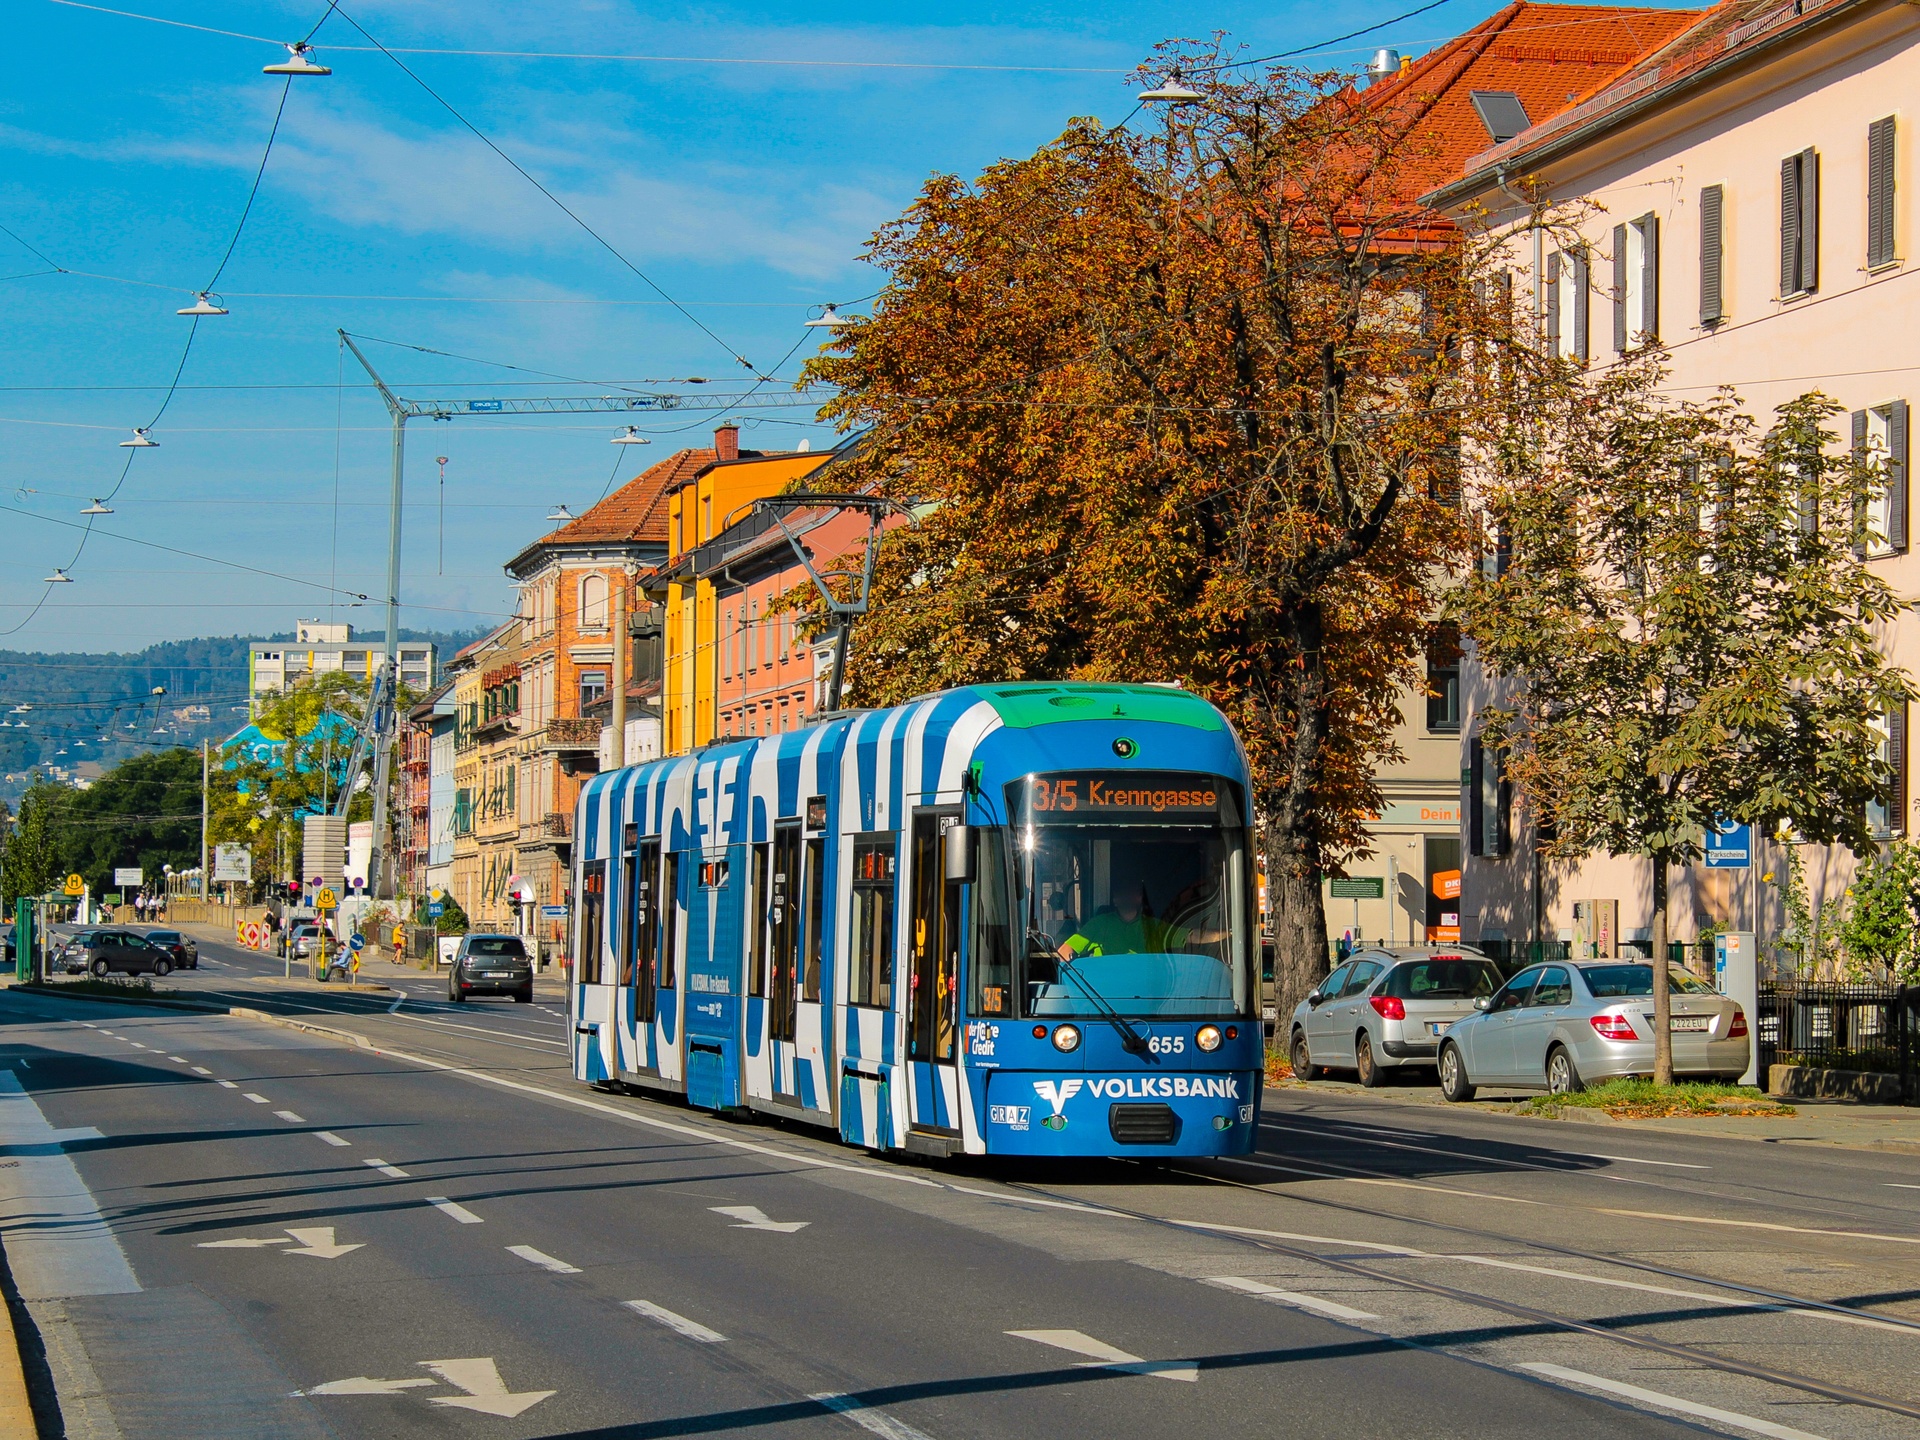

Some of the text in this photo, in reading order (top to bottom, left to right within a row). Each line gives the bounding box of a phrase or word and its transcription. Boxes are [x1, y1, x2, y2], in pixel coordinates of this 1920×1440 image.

[1032, 780, 1217, 812] 3/5 Krenngasse
[1421, 807, 1452, 820] Dein
[1710, 850, 1746, 858] Parkscheine
[984, 987, 1002, 1012] 3/5
[1676, 1019, 1702, 1028] 222 EU
[972, 1038, 995, 1056] Credit
[1149, 1036, 1185, 1054] 655
[1087, 1077, 1240, 1099] VOLKSBANK
[990, 1105, 1030, 1124] GRAZ
